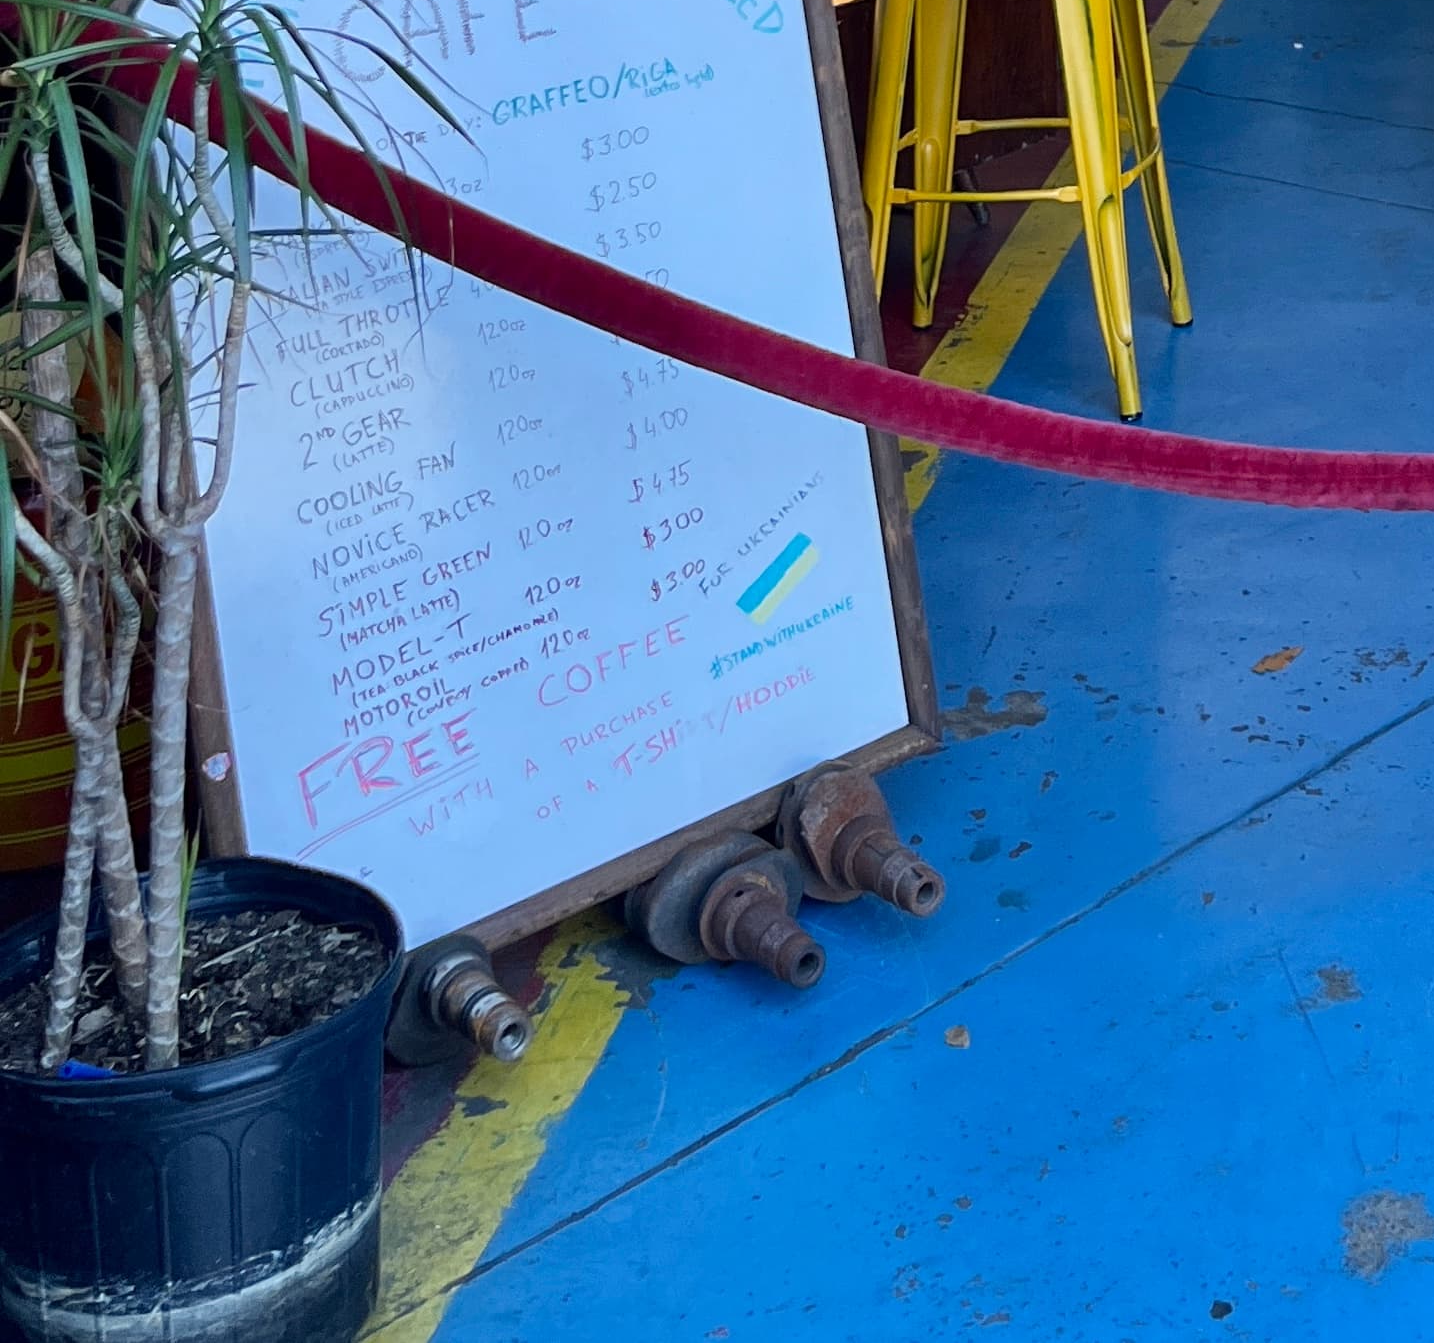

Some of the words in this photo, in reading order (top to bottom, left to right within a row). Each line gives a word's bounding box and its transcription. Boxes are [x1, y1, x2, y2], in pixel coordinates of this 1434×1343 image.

[583, 171, 657, 213] $2.50
[596, 220, 662, 258] $3.50
[275, 329, 331, 363] FULL
[288, 348, 403, 408] CLUTCH
[341, 407, 413, 447] GEAR
[332, 437, 396, 473] (LATTE)
[416, 440, 457, 480] FAN
[419, 488, 497, 534] RACER
[421, 540, 492, 587] GREEN
[339, 614, 408, 653] (MATCHA
[410, 587, 462, 624] LATTE)
[331, 612, 473, 697] MODEL-T
[393, 659, 440, 688] BLACK
[297, 707, 478, 831] FREE
[538, 614, 691, 706] COFFEE
[523, 758, 540, 780] A
[560, 690, 675, 757] PURCHASE
[536, 794, 565, 820] OF
